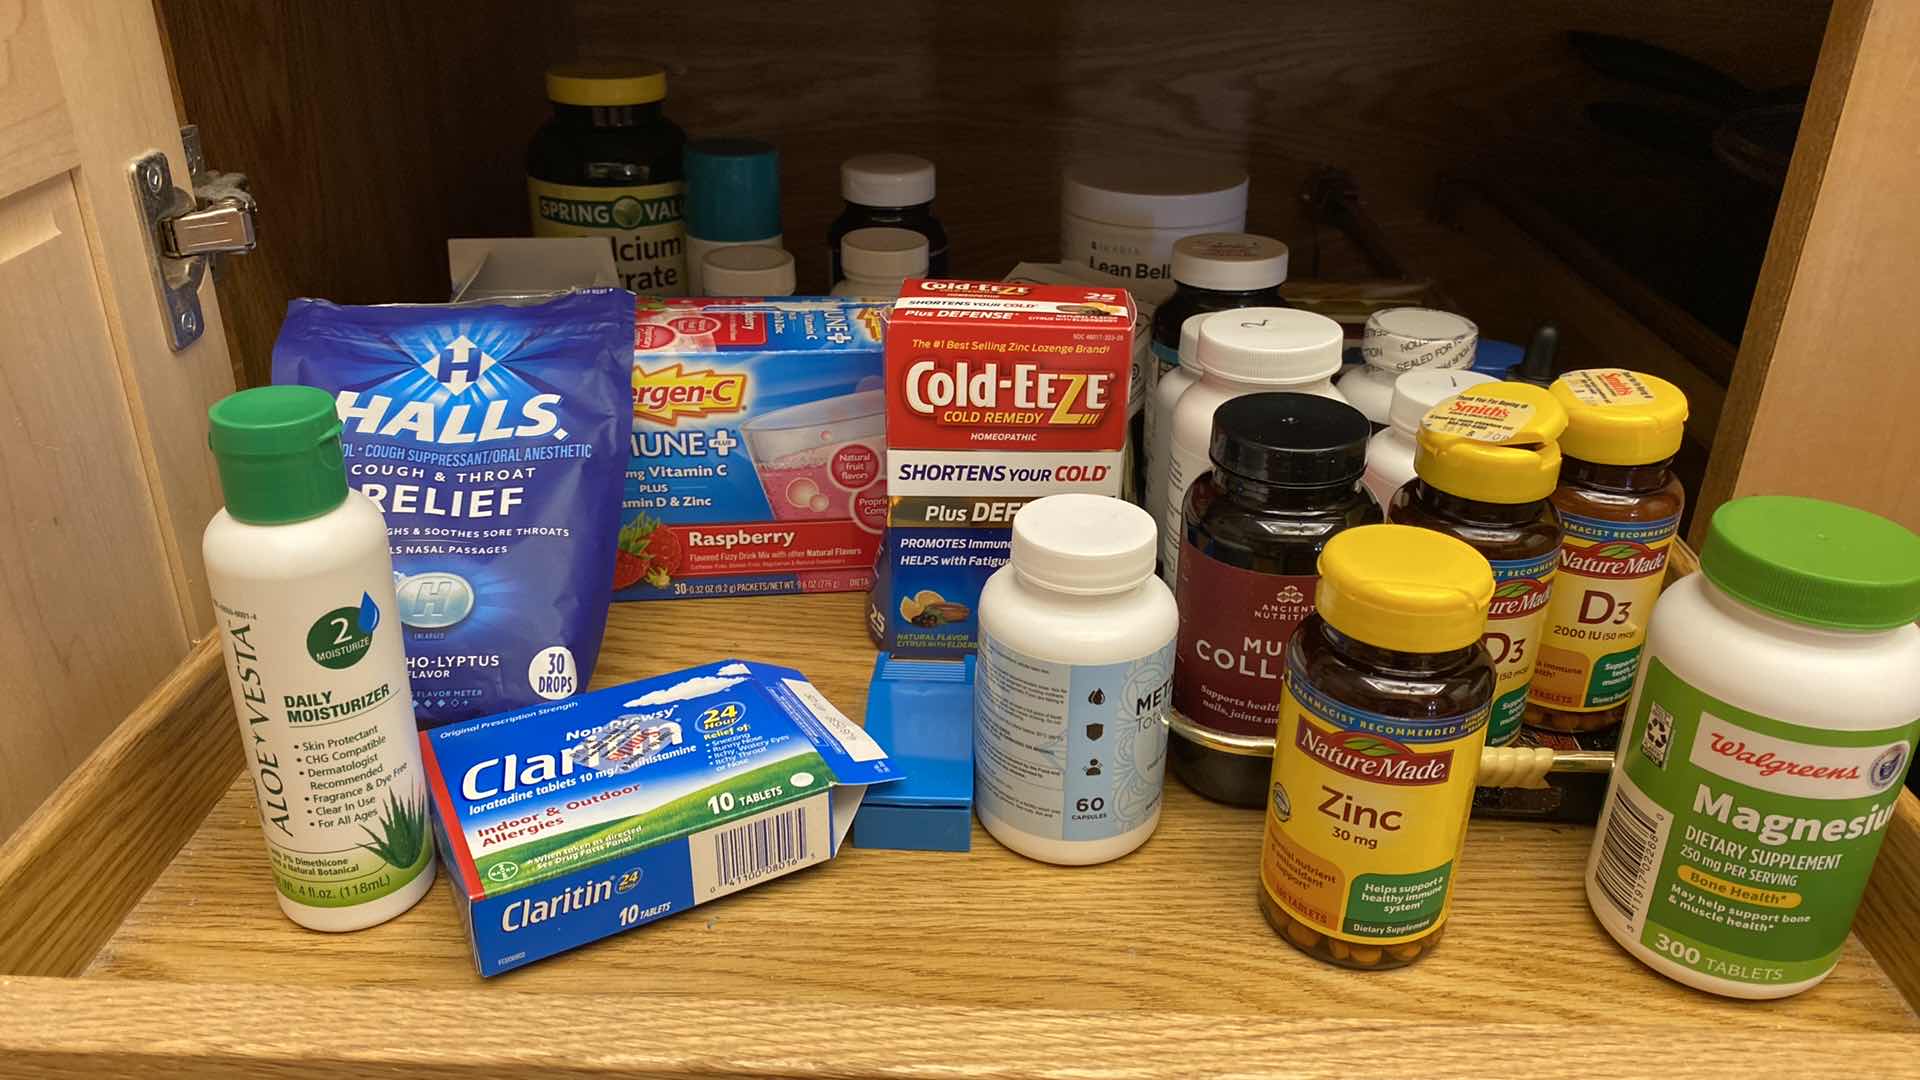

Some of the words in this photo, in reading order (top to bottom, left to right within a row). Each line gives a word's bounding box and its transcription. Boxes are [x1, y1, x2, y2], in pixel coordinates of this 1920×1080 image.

[541, 200, 610, 224] SPRING
[644, 199, 681, 221] VAL
[611, 235, 681, 262] lcium
[617, 265, 678, 291] rate
[1089, 256, 1131, 278] Lean
[1135, 263, 1170, 280] Bell
[909, 299, 971, 307] SHORTENS
[1083, 292, 1117, 301] 25
[904, 310, 935, 318] Plus
[936, 310, 1015, 320] DEFENSE
[911, 339, 931, 350] The
[932, 339, 945, 350] #1
[946, 340, 970, 351] Best
[971, 341, 1007, 353] Selling
[1008, 341, 1030, 352] Zinc
[1031, 343, 1074, 354] Lozenge
[1396, 352, 1433, 371] SEALED
[1434, 342, 1452, 357] FOR
[631, 379, 736, 410] ergen-C
[943, 411, 980, 424] COLD
[984, 411, 1045, 425] REMEDY
[970, 432, 1038, 442] HOMEOPATHIC
[365, 443, 406, 460] COUGH
[407, 447, 521, 467] SUPPRESSANT/ORAL
[523, 443, 593, 462] ANESTHETIC
[839, 453, 871, 463] Natural
[350, 463, 425, 480] COUGH
[434, 470, 446, 482] &
[456, 466, 537, 484] THROAT
[624, 470, 645, 481] mg
[649, 465, 713, 478] Vitamin
[716, 464, 728, 477] C
[845, 462, 864, 472] fruit
[898, 463, 1007, 482] SHORTENS
[1008, 468, 1052, 482] YOUR
[1054, 464, 1107, 482] COLD
[639, 484, 669, 493] PLUS
[360, 483, 525, 519] RELIEF
[656, 497, 667, 508] D
[669, 497, 681, 508] &
[683, 496, 712, 507] Zinc
[925, 505, 968, 522] Plus
[413, 528, 422, 537] &
[424, 527, 481, 538] SOOTHES
[483, 528, 513, 539] SORE
[516, 526, 570, 537] THROATS
[688, 529, 796, 550] Raspberry
[405, 545, 446, 555] NASAL
[448, 545, 509, 555] PASSAGES
[806, 548, 834, 558] Natural
[834, 547, 862, 557] Flavors
[900, 538, 967, 549] PROMOTES
[900, 555, 939, 567] HELPS
[941, 554, 967, 567] with
[1254, 611, 1305, 621] NUTRITI
[1262, 603, 1316, 613] ANCIENT
[1577, 590, 1633, 626] D3
[330, 617, 353, 645] 2
[896, 633, 936, 642] NATURAL
[936, 633, 969, 641] FLAVOR
[1553, 625, 1586, 640] 2000
[1588, 629, 1602, 641] IU
[316, 636, 370, 662] MOISTURIZE
[1196, 639, 1284, 680] COLL
[405, 654, 500, 670] HO-LYPTUS
[546, 652, 566, 676] 30
[230, 622, 270, 726] VESTA
[407, 669, 451, 679] FLAVOR
[538, 674, 573, 694] DROPS
[283, 690, 332, 709] DAILY
[287, 683, 391, 723] MOISTURIZER
[456, 688, 483, 697] METER
[1136, 674, 1175, 716] MET
[1200, 684, 1246, 708] Supports
[439, 724, 480, 740] Original
[480, 711, 537, 730] Prescription
[538, 699, 579, 717] Strength
[703, 704, 738, 724] 24
[704, 717, 737, 730] Hour
[1229, 705, 1262, 724] joints
[302, 741, 325, 752] Skin
[327, 725, 379, 749] Protectant
[770, 735, 790, 744] Eyes
[1359, 720, 1457, 738] RECOMMENDED
[305, 755, 329, 765] CHG
[332, 735, 387, 762] Compatible
[1709, 731, 1862, 783] Walgreens
[307, 752, 379, 779] Dermatologist
[310, 763, 384, 791] Recommended
[258, 752, 294, 838] ALOE
[312, 786, 364, 804] Fragrance
[366, 782, 374, 792] &
[375, 774, 392, 789] Dye
[468, 789, 534, 816] loratadine
[535, 775, 577, 799] tablets
[579, 771, 593, 784] 10
[315, 805, 342, 816] Clear
[344, 803, 356, 811] In
[357, 796, 376, 807] Use
[477, 811, 540, 839] Indoor
[545, 805, 561, 818] &
[565, 783, 641, 812] Outdoor
[706, 792, 736, 816] 10
[738, 785, 784, 808] TABLETS
[1075, 796, 1105, 813] 60
[1317, 785, 1403, 832] Zinc
[317, 819, 335, 829] For
[336, 815, 351, 825] All
[353, 809, 379, 825] Ages
[1071, 813, 1108, 821] CAPSULES
[1692, 783, 1898, 846] Magnesiu
[481, 816, 566, 848] Allergies
[1331, 826, 1351, 842] 30
[1353, 835, 1378, 850] mg
[1685, 824, 1748, 860] DIETARY
[1749, 848, 1844, 873] SUPPLEMENT
[1679, 843, 1703, 863] 250
[1702, 854, 1722, 873] mg
[1723, 861, 1746, 879] PER
[1748, 868, 1800, 888] SERVING
[1364, 883, 1399, 894] Helps
[1399, 878, 1438, 895] support
[1689, 871, 1728, 895] Bone
[501, 878, 612, 933] Claritin
[1361, 891, 1403, 905] healthy
[1404, 885, 1443, 902] immune
[1671, 883, 1696, 904] May
[1696, 894, 1727, 915] help
[1727, 906, 1780, 926] support
[1780, 913, 1812, 925] bone
[619, 904, 640, 927] 10
[640, 901, 672, 920] TABLETS
[1667, 893, 1678, 906] &
[1678, 898, 1725, 924] muscle
[1352, 923, 1386, 935] Dietary
[1386, 918, 1431, 934] Supplement
[1655, 932, 1702, 966] 300
[1704, 956, 1785, 982] TABLETS
